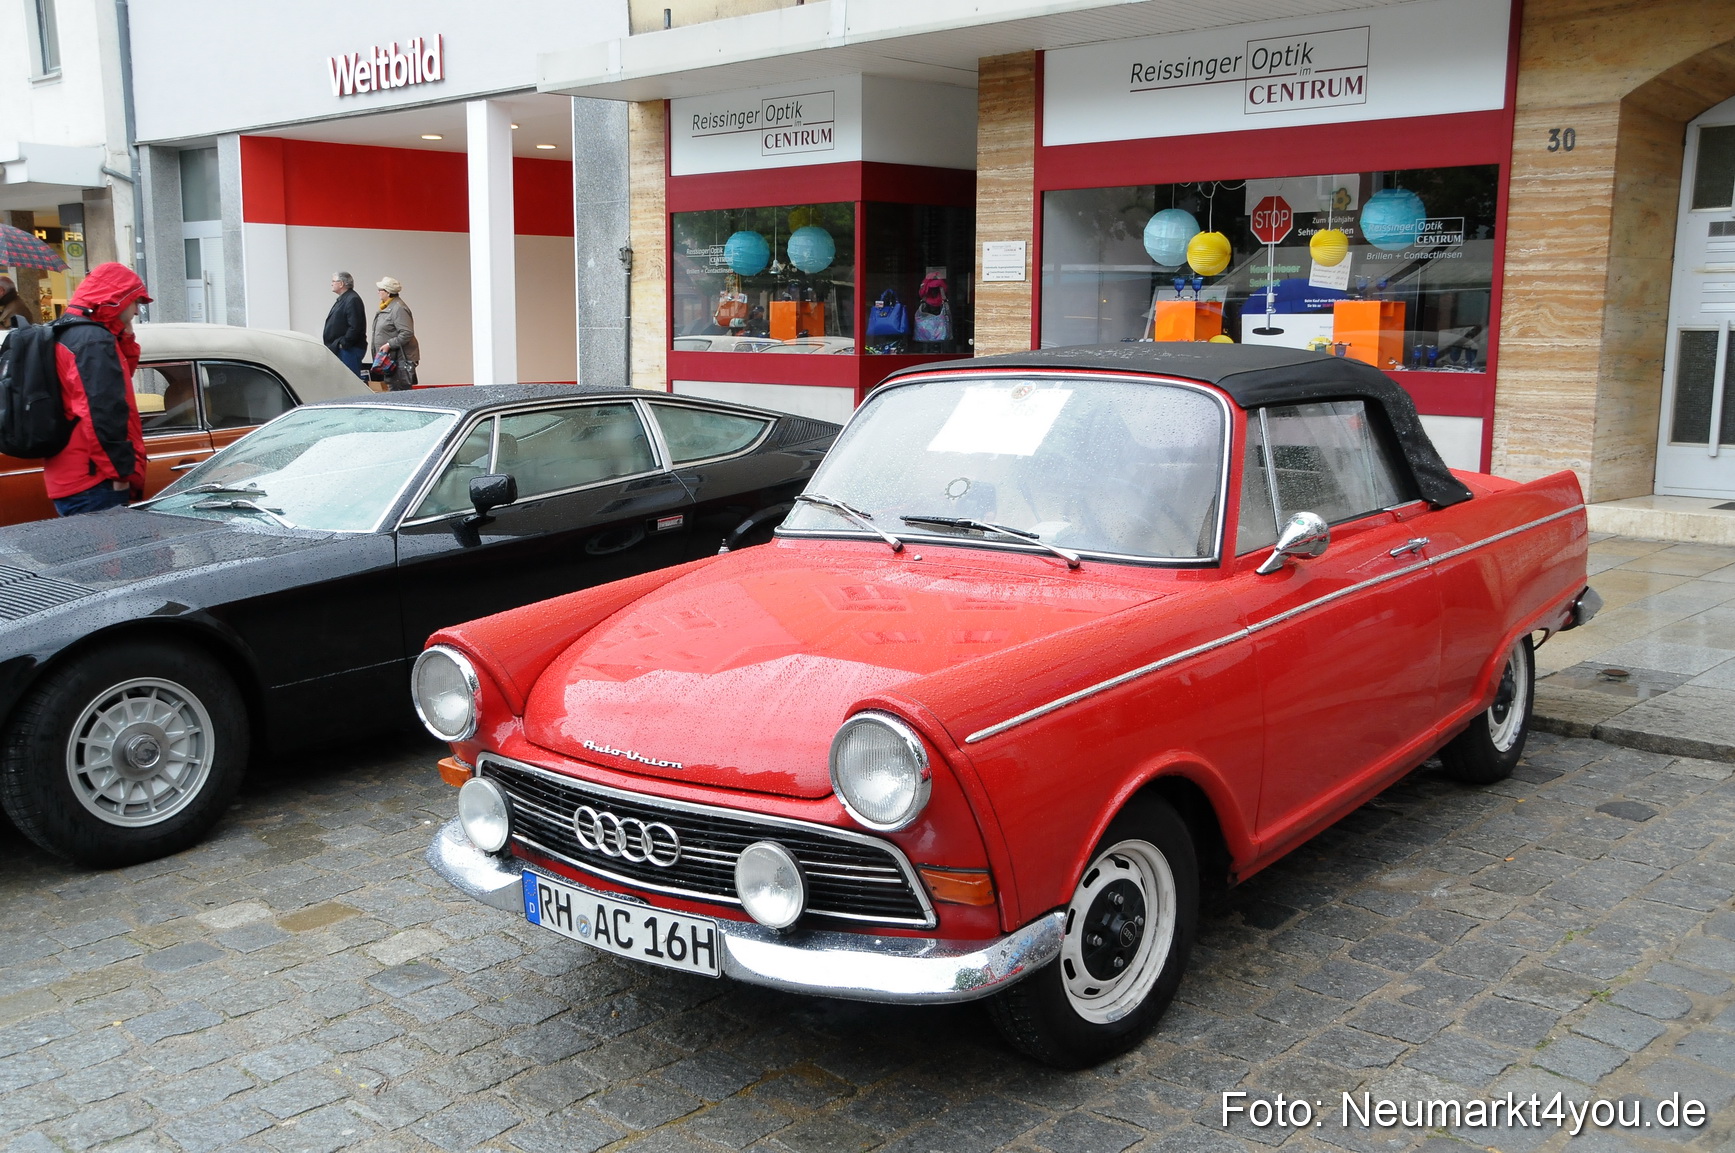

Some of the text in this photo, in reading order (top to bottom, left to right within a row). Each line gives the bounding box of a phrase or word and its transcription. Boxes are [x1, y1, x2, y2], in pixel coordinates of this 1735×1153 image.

[327, 33, 444, 97] Weltbild
[1131, 42, 1314, 83] Reissinger Optik
[1300, 66, 1312, 76] im
[1249, 75, 1363, 105] CENTRUM
[692, 101, 803, 130] Reissinger Optik
[764, 128, 832, 149] CENTRUM
[1547, 128, 1576, 152] 30
[1255, 210, 1290, 228] STOP
[1368, 221, 1443, 232] Reissinger Optik
[1417, 235, 1461, 244] CENTRUM
[1404, 251, 1463, 259] Contactlinsen
[529, 902, 535, 913] D
[538, 883, 716, 969] RH AC 16H
